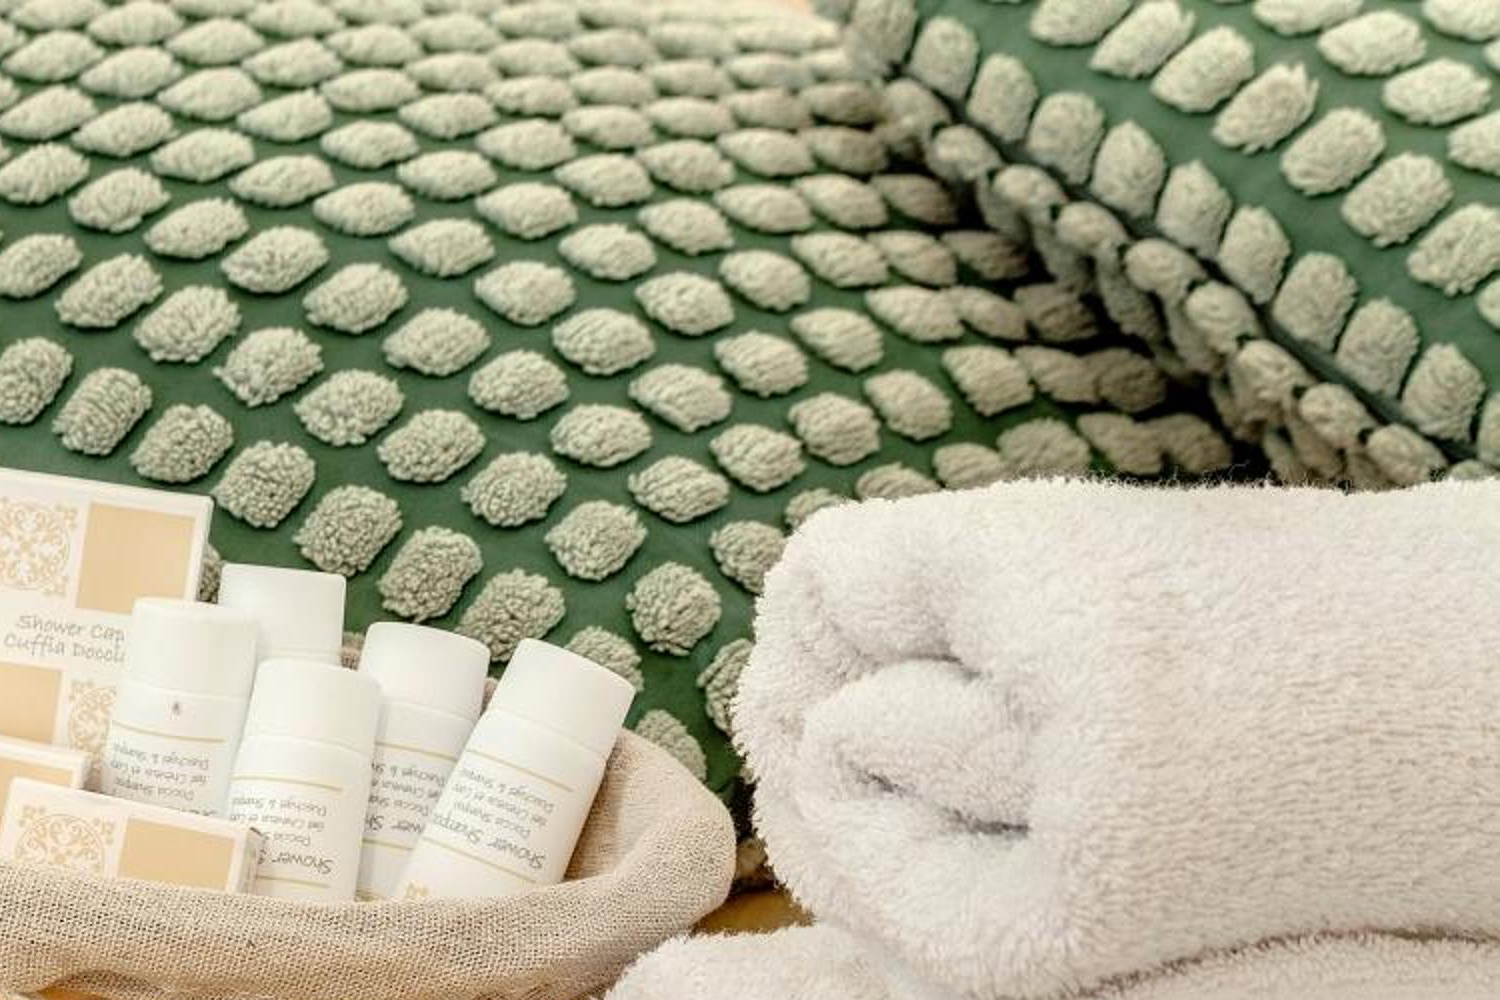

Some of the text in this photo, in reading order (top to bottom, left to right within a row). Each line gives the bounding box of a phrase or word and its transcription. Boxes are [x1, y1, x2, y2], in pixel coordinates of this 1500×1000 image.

[3, 633, 65, 657] Cuffia
[15, 615, 125, 648] Shower Cap
[270, 851, 335, 875] Shower
[486, 837, 547, 870] Shower
